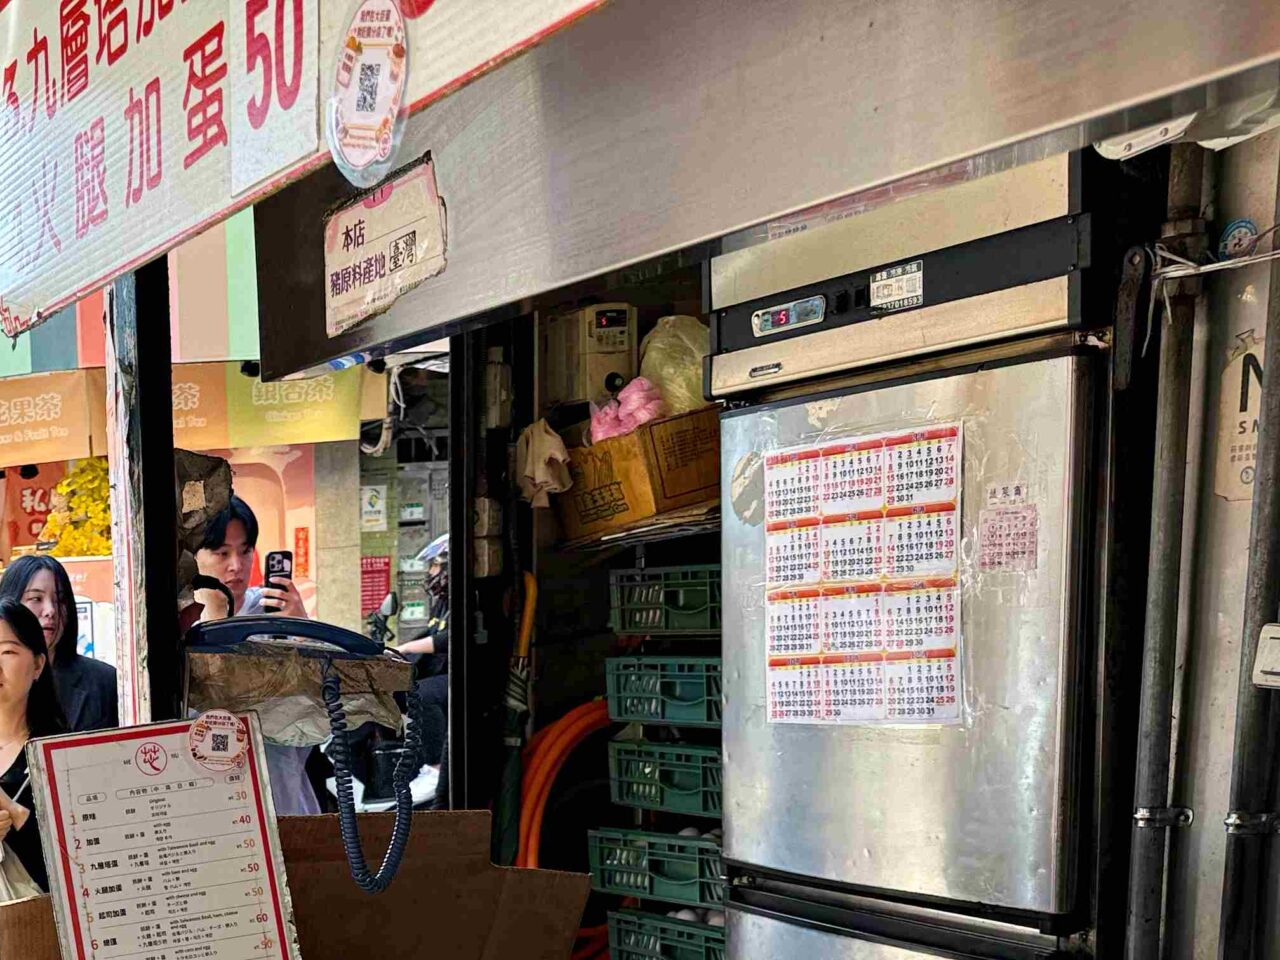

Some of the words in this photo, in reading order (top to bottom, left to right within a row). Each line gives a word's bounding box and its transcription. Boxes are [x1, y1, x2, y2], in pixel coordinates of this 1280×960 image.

[245, 0, 303, 129] 50
[342, 218, 366, 252] 本店
[330, 251, 386, 298] 豬原料產地
[252, 376, 335, 406] 銀杏茶
[888, 453, 893, 461] 1
[898, 451, 903, 460] 2
[907, 450, 912, 458] 3
[917, 448, 921, 456] 4
[927, 447, 932, 455] 5
[937, 445, 941, 453] 6
[947, 444, 952, 452] 7
[888, 463, 893, 472] 8
[898, 462, 903, 470] 9
[905, 460, 914, 469] 10
[915, 459, 923, 467] 11
[925, 457, 934, 466] 12
[935, 456, 943, 464] 13
[945, 454, 954, 463] 14
[886, 474, 895, 482] 15
[896, 472, 905, 481] 16
[905, 471, 914, 479] 17
[915, 469, 923, 478] 18
[925, 468, 934, 476] 19
[935, 466, 943, 475] 20
[945, 465, 954, 473] 21
[886, 485, 895, 493] 22
[896, 484, 905, 492] 23
[905, 482, 914, 491] 24
[915, 481, 923, 489] 25
[925, 480, 934, 488] 26
[935, 478, 943, 487] 27
[945, 477, 954, 486] 28
[886, 495, 895, 504] 29
[896, 494, 905, 503] 30
[905, 493, 914, 501] 31
[236, 791, 247, 800] 30
[239, 815, 251, 823] 40
[74, 839, 81, 849] 2
[243, 839, 255, 848] 50
[79, 863, 85, 873] 3
[248, 863, 259, 872] 50
[82, 888, 89, 898] 4
[252, 887, 263, 896] 50
[256, 913, 268, 923] 60
[91, 939, 98, 950] 6
